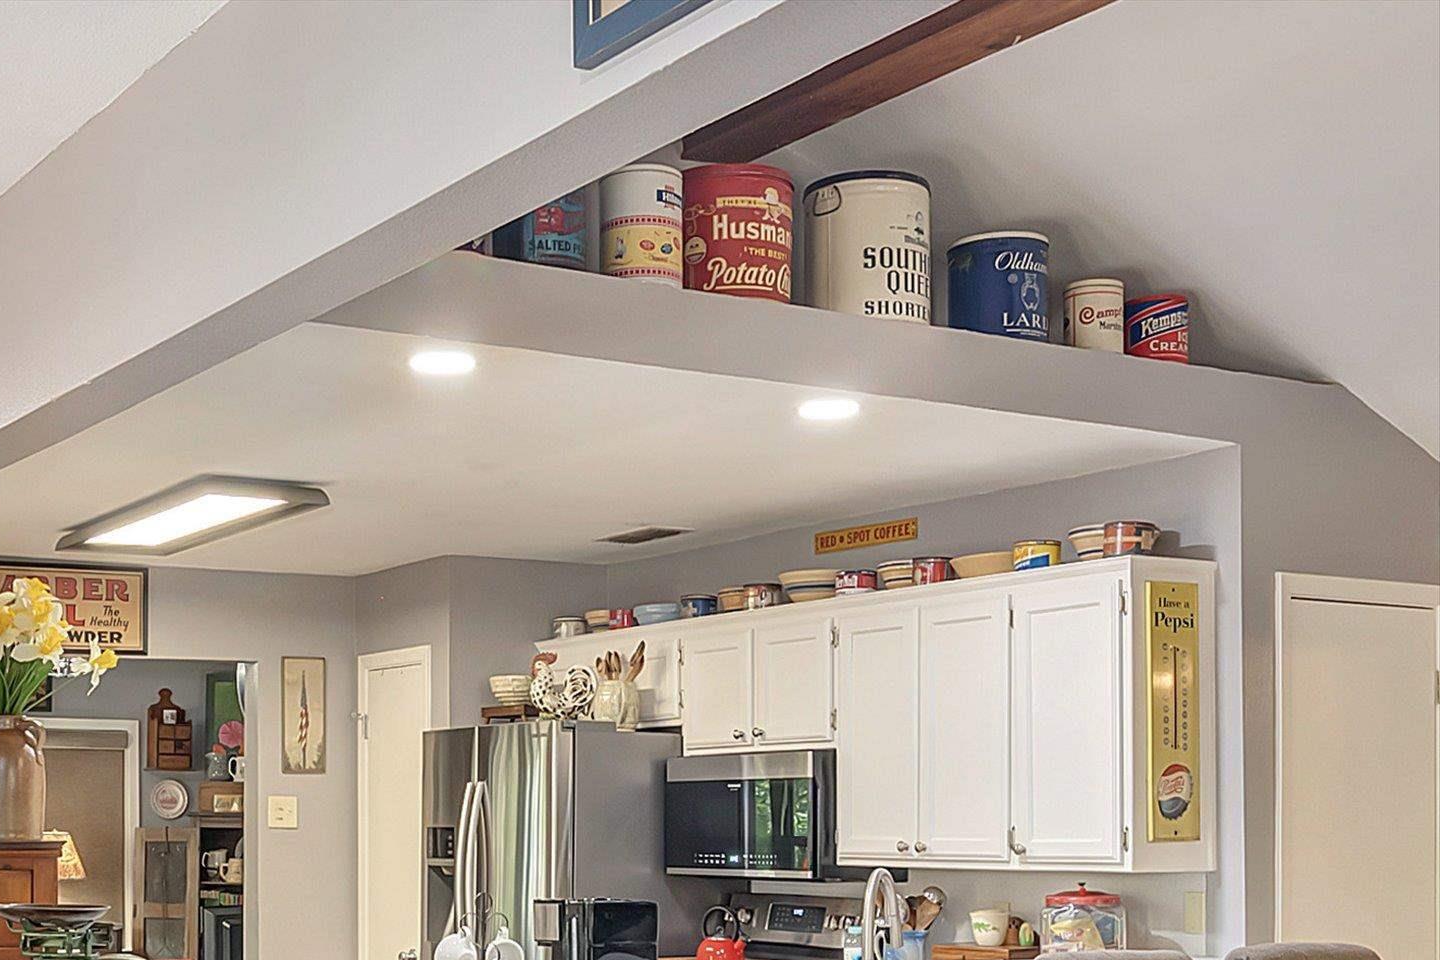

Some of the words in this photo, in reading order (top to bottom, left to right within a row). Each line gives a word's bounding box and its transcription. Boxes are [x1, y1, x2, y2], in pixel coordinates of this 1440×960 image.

[703, 257, 776, 290] Potato
[820, 535, 836, 549] RED
[847, 529, 871, 544] SPOT
[874, 523, 910, 540] COFFEE
[1158, 597, 1181, 609] Have
[103, 605, 120, 617] The
[89, 617, 129, 632] Healthy
[1154, 611, 1195, 634] Pepsi
[67, 631, 123, 643] WDER
